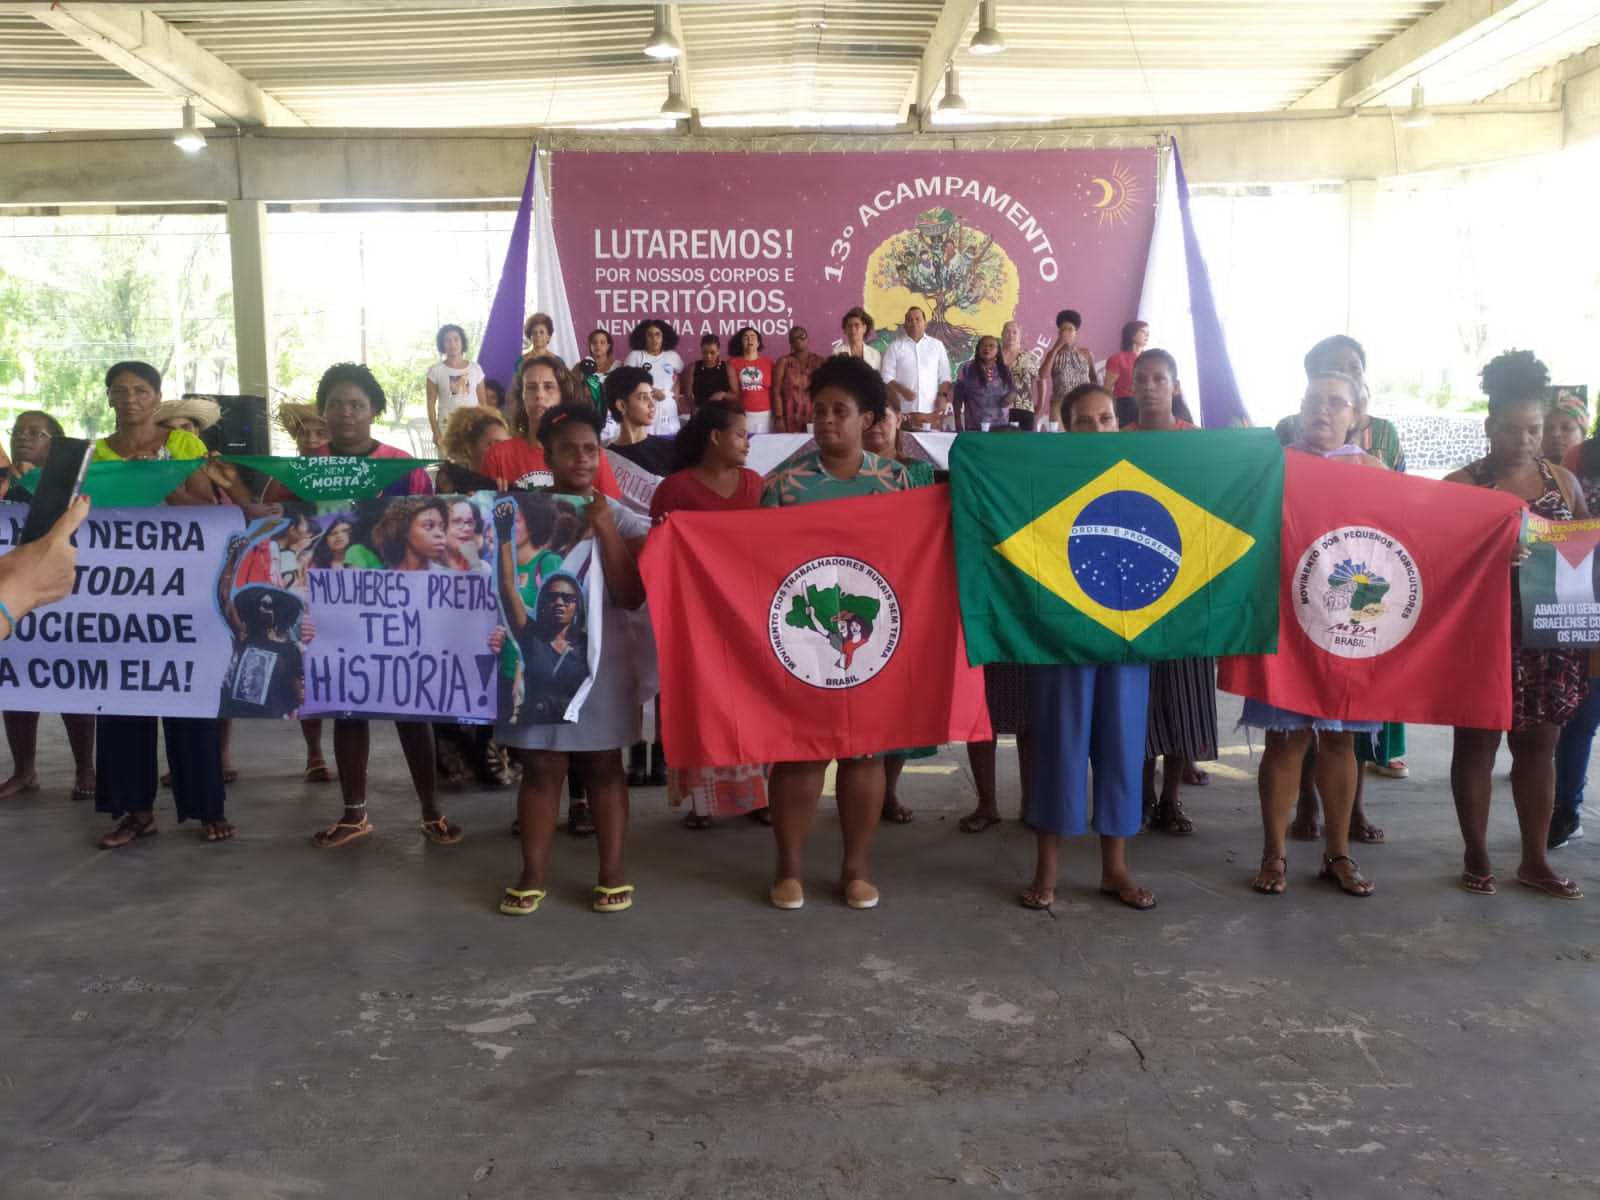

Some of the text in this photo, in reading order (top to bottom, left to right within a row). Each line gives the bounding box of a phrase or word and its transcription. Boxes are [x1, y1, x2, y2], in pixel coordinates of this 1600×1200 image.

[594, 229, 793, 259] LUTAREMOS!
[857, 176, 1059, 283] ACAMPAMENTO
[595, 267, 795, 282] POR NOSSOS CORPOS E
[594, 283, 793, 317] TERRITÓRIOS,
[597, 319, 694, 335] NENMA
[700, 319, 713, 335] A
[1034, 333, 1051, 361] DE
[308, 456, 357, 467] PRESA
[324, 466, 345, 475] NEM
[312, 476, 360, 488] MORTA
[88, 520, 205, 551] NEGRA
[1071, 526, 1108, 535] ORDEM
[1124, 530, 1180, 562] PROGRESSO
[72, 565, 185, 596] TODA A
[1300, 530, 1418, 620] MOVIMENTO DOS PEQUENOS AGRICULTORES
[308, 570, 498, 611] MULHERES PRETAS
[4, 611, 197, 643] OCIEDADE
[359, 610, 421, 647] TEM
[771, 558, 898, 670] MOVIMENTO DOS TRABALHADORES RURAIS SEM TERRA
[1533, 616, 1587, 629] ISRAELENSE
[1335, 636, 1367, 648] BRASIL
[1557, 631, 1570, 642] OS
[28, 658, 108, 690] COM
[120, 660, 195, 692] ELA!
[825, 675, 860, 686] BRASIL
